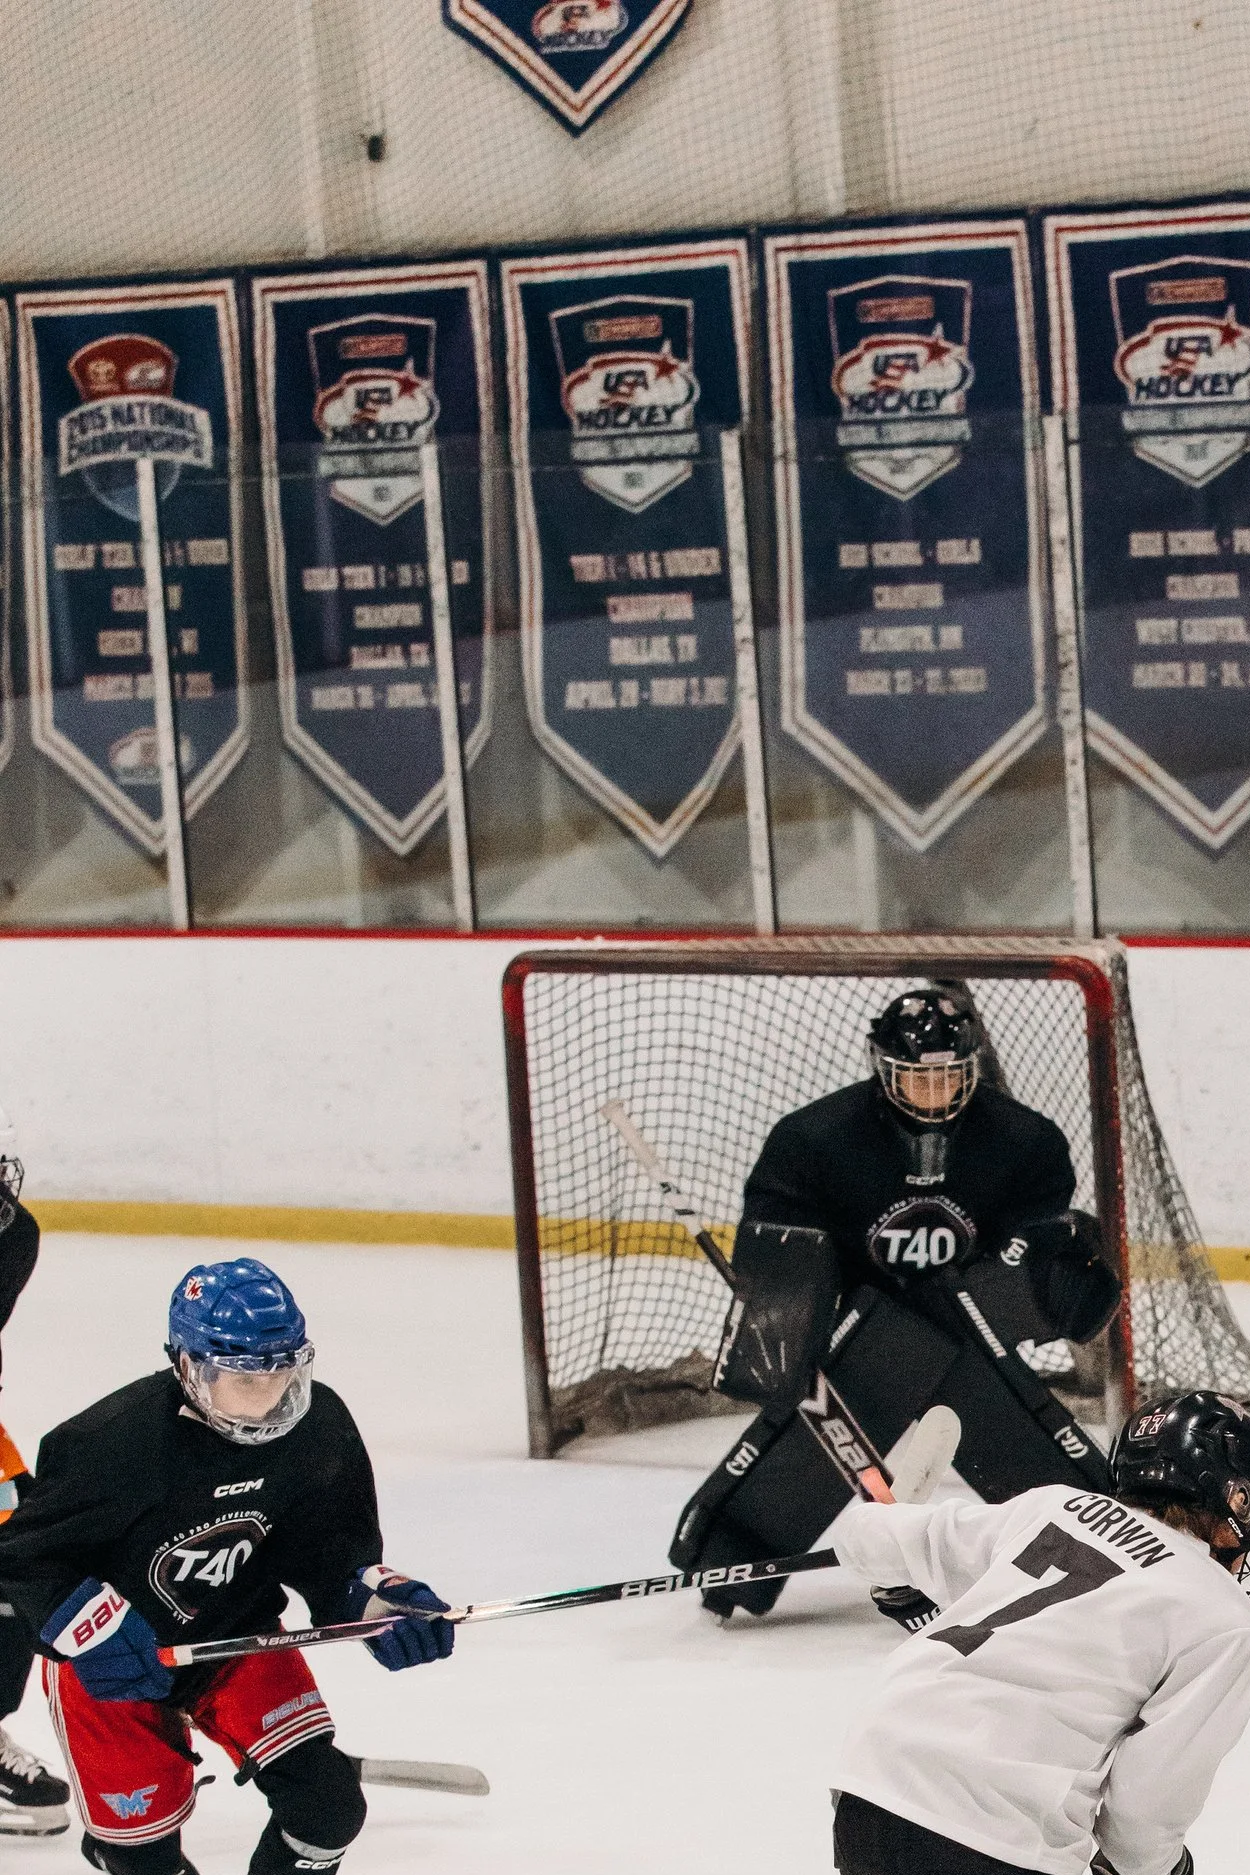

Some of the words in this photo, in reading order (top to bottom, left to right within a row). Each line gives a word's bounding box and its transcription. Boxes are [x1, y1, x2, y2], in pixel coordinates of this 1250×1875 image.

[1135, 373, 1248, 398] HOCKEY
[849, 389, 947, 413] HOCKEY
[577, 406, 678, 430] HOCKEY
[879, 1226, 957, 1270] T40
[1133, 1412, 1168, 1438] 77
[213, 1478, 265, 1498] CCM
[189, 1521, 210, 1536] PRO
[1063, 1494, 1176, 1569] CORWIN
[620, 1563, 754, 1600] BAUER
[926, 1521, 1126, 1658] 7
[268, 1631, 322, 1648] BAUER
